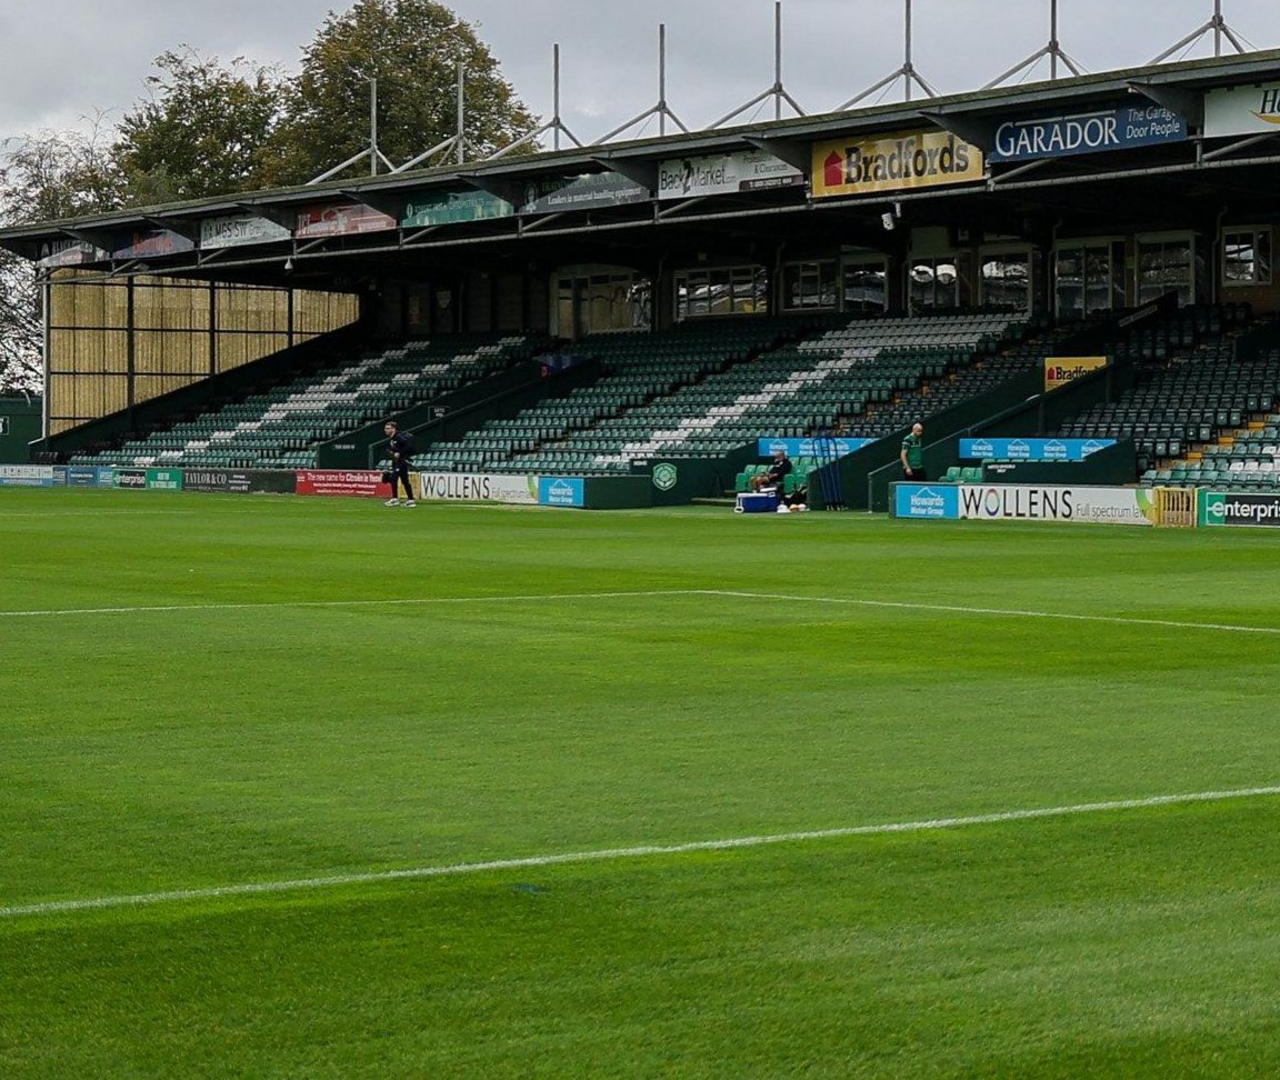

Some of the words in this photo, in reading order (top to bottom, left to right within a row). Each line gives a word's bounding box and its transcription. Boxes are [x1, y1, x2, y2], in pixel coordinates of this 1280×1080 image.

[1128, 108, 1144, 123] The
[995, 117, 1119, 157] GARADOR
[1126, 124, 1147, 139] Door
[1150, 120, 1181, 137] People
[844, 138, 970, 185] Bradfords
[423, 476, 490, 499] WOLLENS
[962, 488, 1073, 519] WOLLENS
[1076, 504, 1089, 516] Full
[1092, 505, 1131, 518] spectrum
